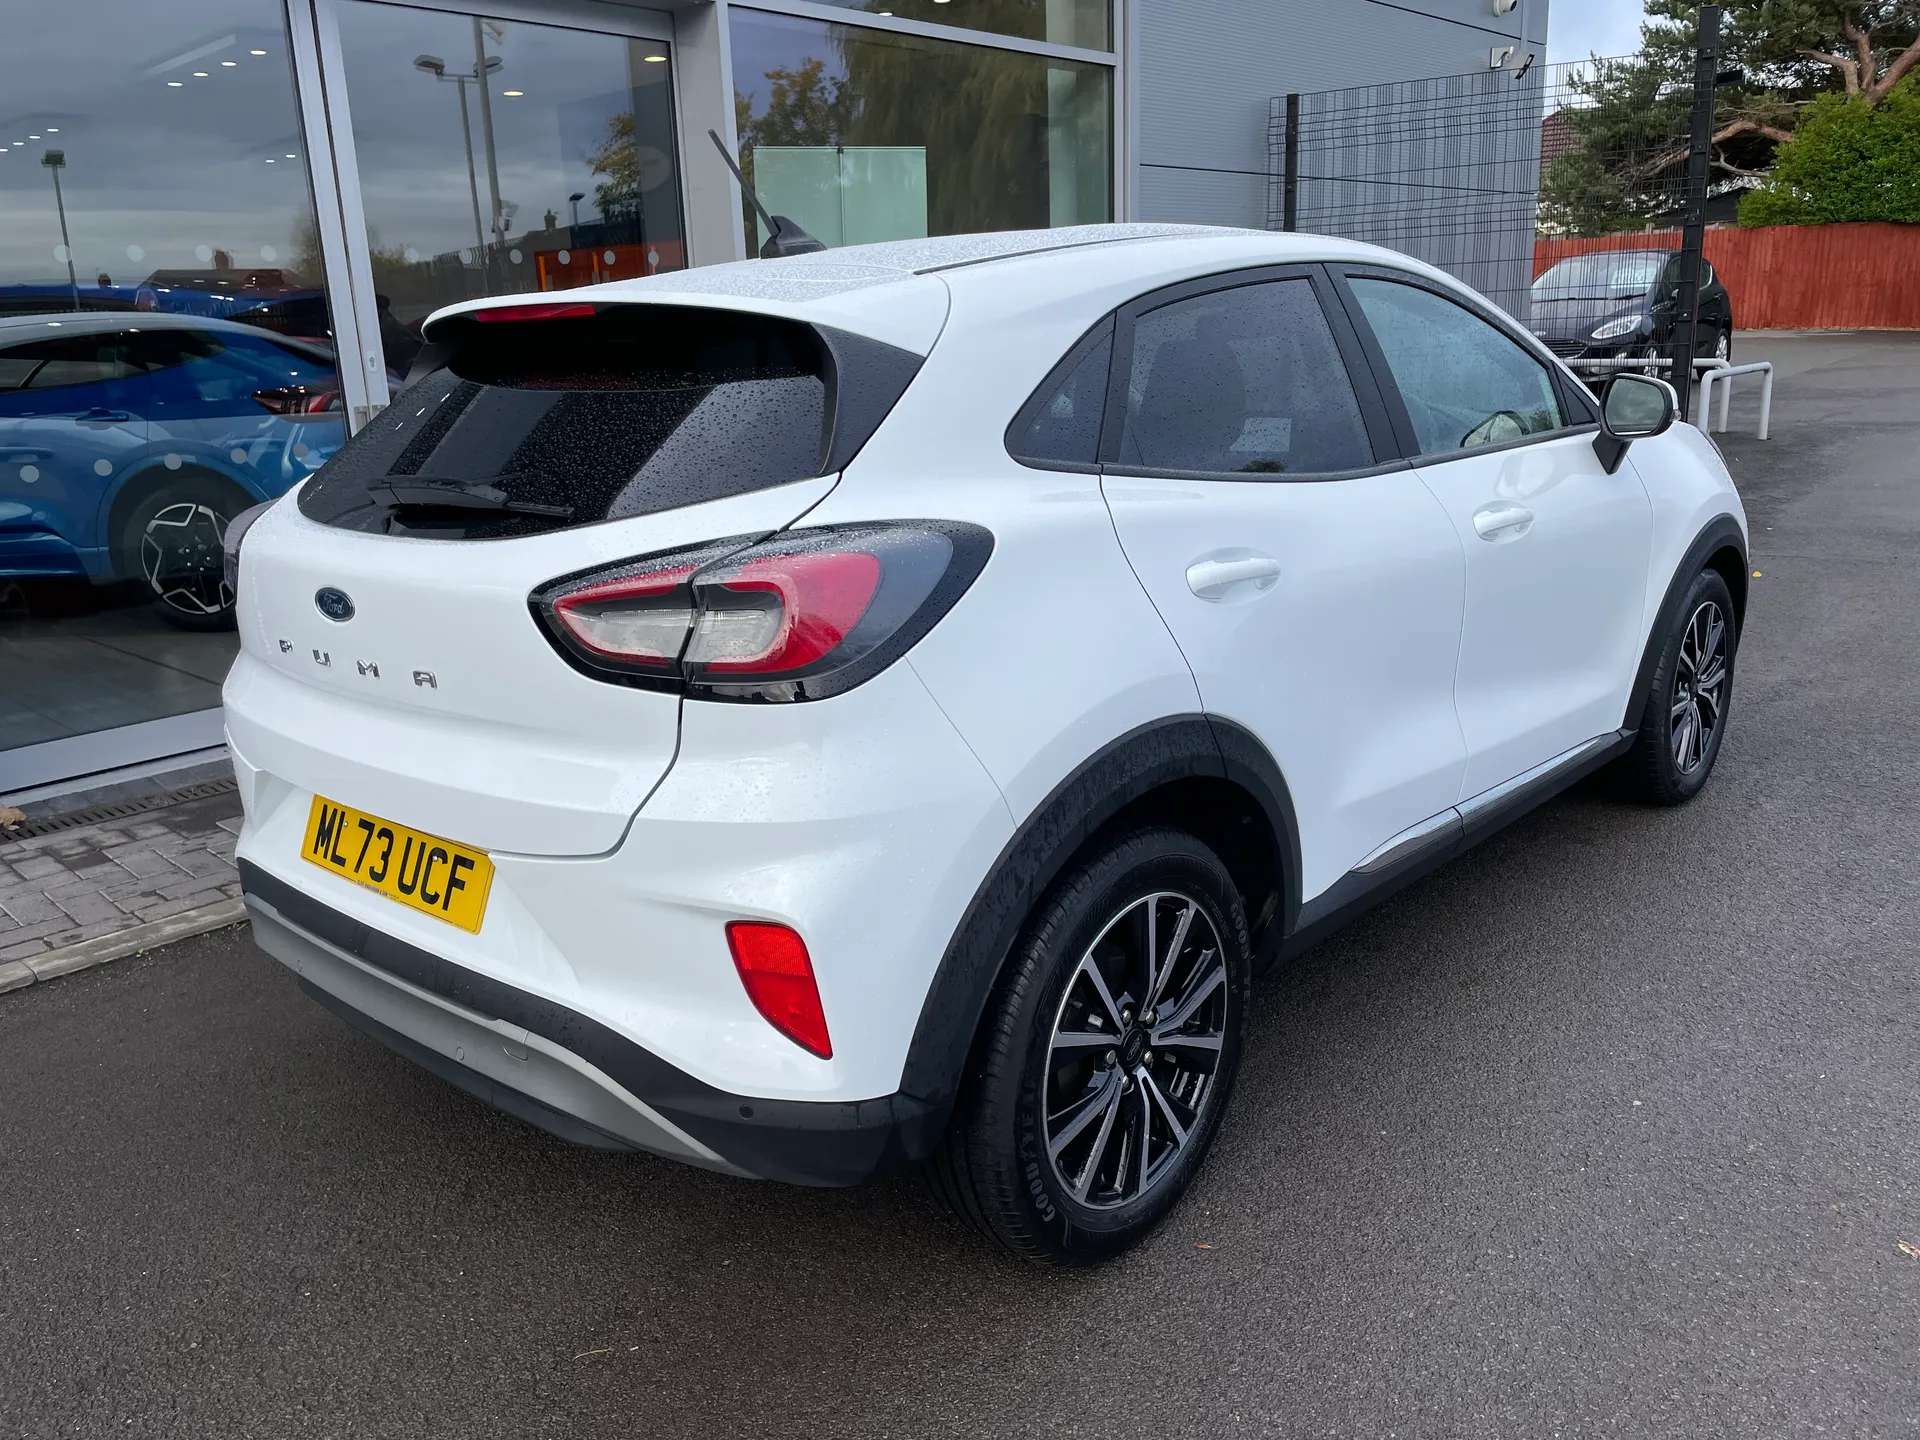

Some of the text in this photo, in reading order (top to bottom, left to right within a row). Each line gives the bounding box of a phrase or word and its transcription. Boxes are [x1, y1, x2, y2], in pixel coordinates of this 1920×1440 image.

[320, 590, 348, 617] Ford
[279, 639, 437, 688] PUMA
[313, 804, 475, 911] ML73 UCF
